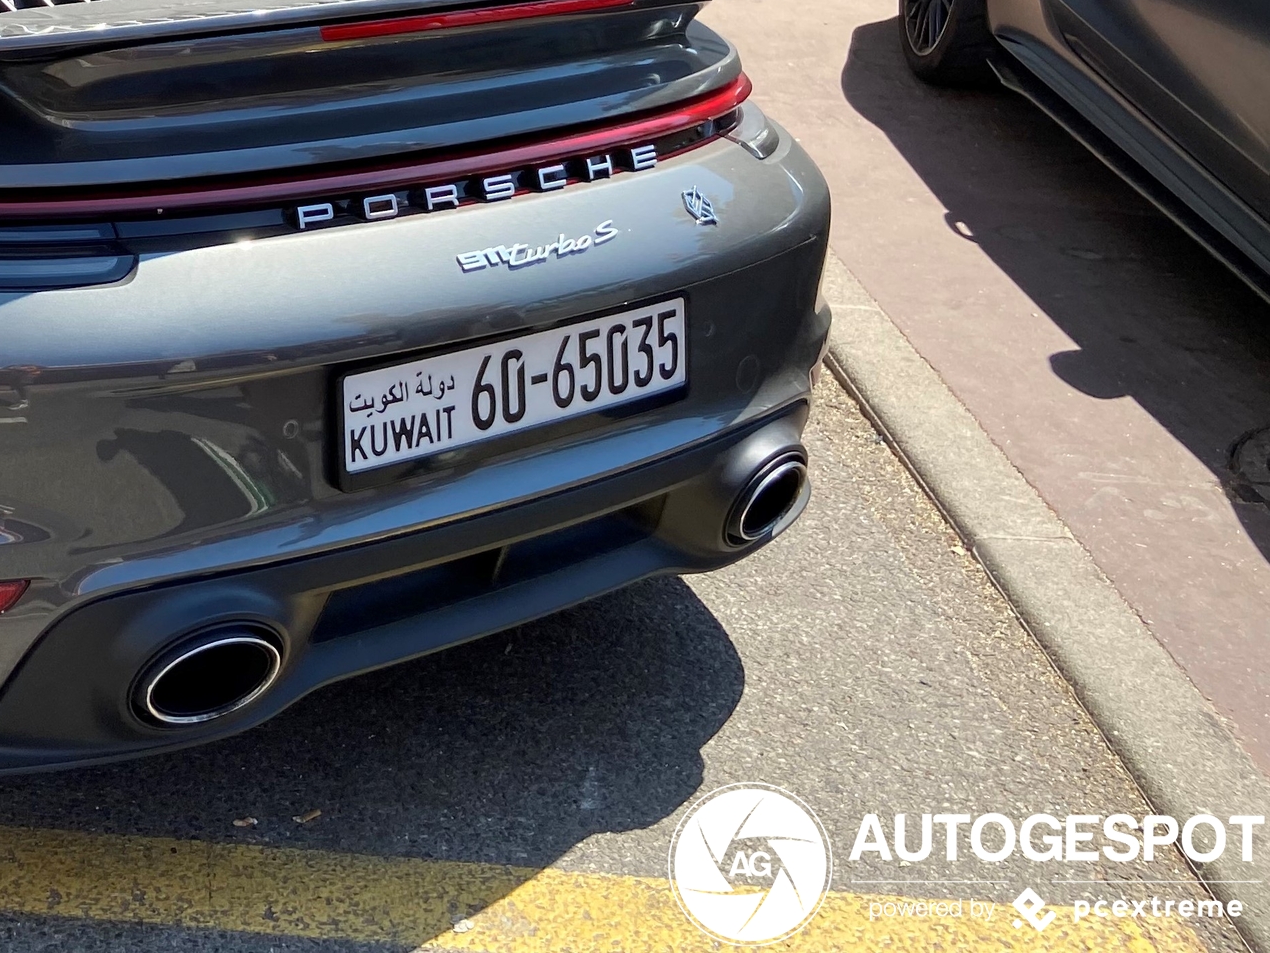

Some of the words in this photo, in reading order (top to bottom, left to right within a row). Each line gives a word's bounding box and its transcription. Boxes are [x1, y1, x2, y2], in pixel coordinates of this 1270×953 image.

[296, 144, 659, 230] PORSCHE
[457, 244, 510, 271] 911
[507, 233, 592, 266] turbo
[594, 219, 619, 244] S
[415, 371, 455, 400] دولة
[471, 308, 678, 431] 60-65035
[349, 380, 408, 418] الكويت
[350, 404, 456, 463] KUWAIT
